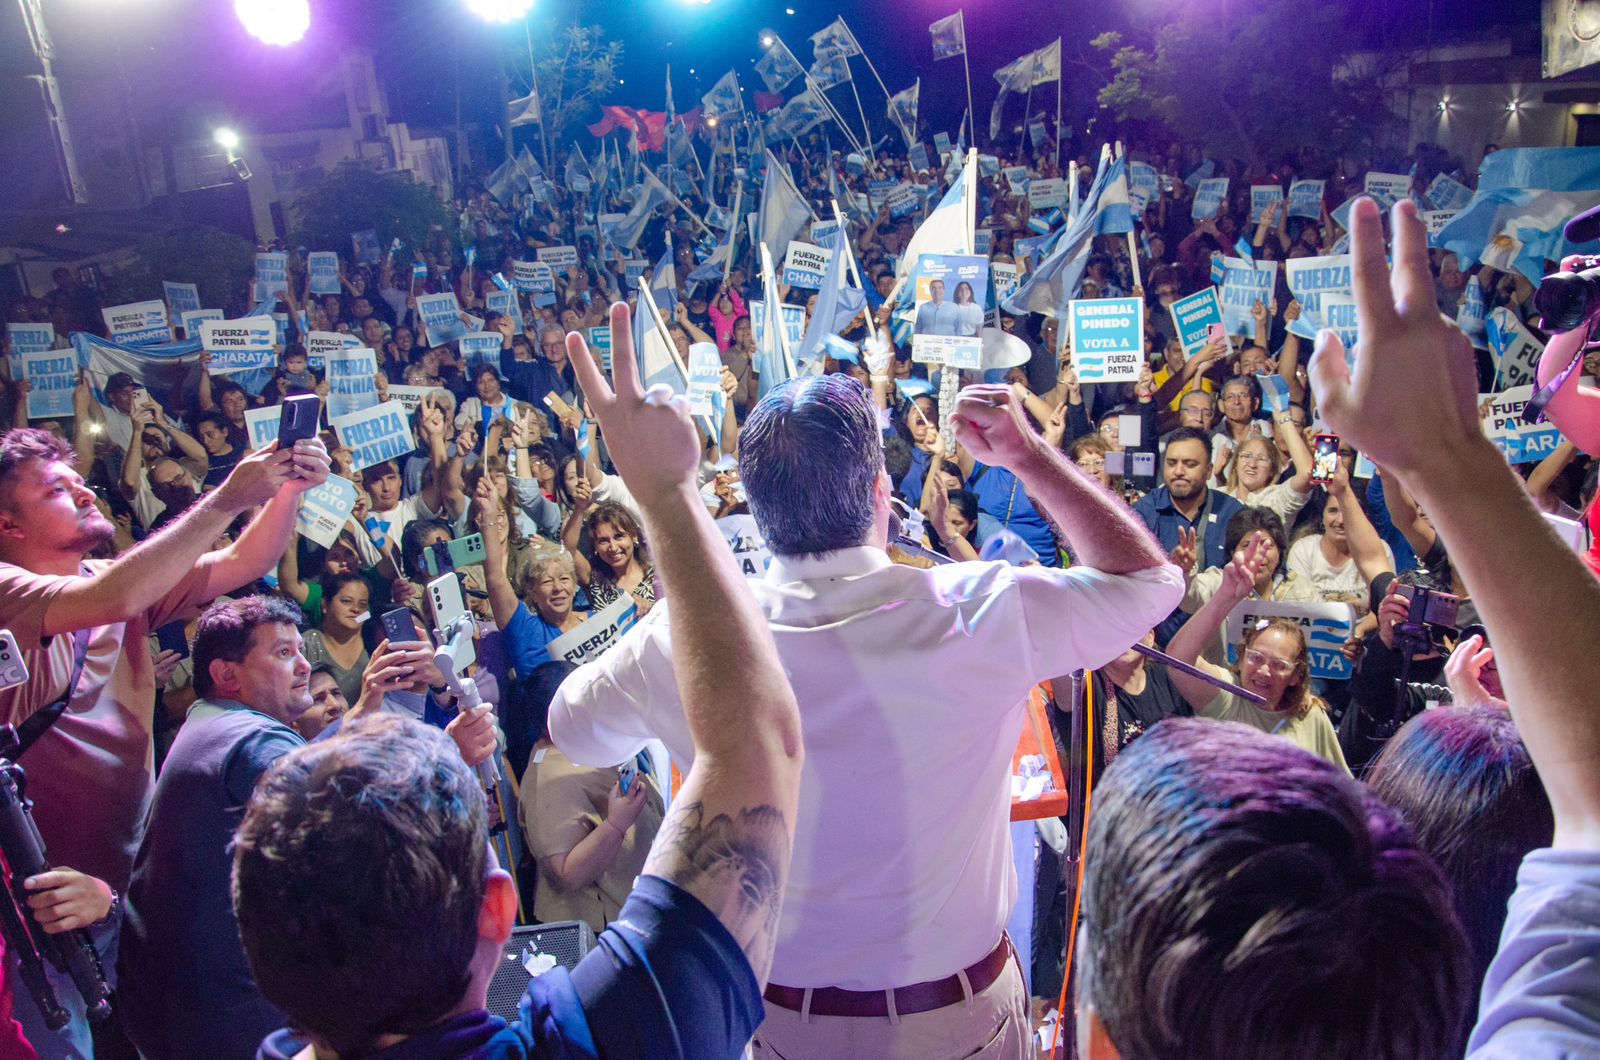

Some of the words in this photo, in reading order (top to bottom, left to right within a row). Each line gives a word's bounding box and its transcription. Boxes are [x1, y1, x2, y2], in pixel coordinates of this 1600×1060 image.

[793, 250, 825, 263] FUERZA
[792, 258, 820, 271] PATRIA
[1226, 267, 1271, 288] FUERZA
[1294, 266, 1351, 290] FUERZA
[422, 299, 456, 313] FUERZA
[1176, 294, 1213, 316] GENERAL
[1296, 292, 1321, 312] PAT
[1077, 304, 1134, 316] GENERAL
[1182, 306, 1213, 325] PINEDO
[112, 312, 145, 323] FUERZA
[424, 312, 461, 328] PATRIA
[1081, 317, 1130, 330] PINEDO
[114, 320, 144, 331] PATRIA
[115, 328, 169, 344] CHARATA
[211, 329, 250, 337] FUERZA
[212, 338, 247, 346] PATRIA
[310, 338, 343, 346] FUERZA
[1083, 339, 1117, 349] VOTA
[1120, 337, 1130, 348] A
[210, 351, 272, 364] CHARATA
[704, 353, 717, 365] YO
[1107, 355, 1137, 363] FUERZA
[28, 358, 74, 375] FUERZA
[330, 358, 374, 376] FUERZA
[1107, 366, 1135, 375] PATRIA
[30, 374, 77, 391] PATRIA
[330, 376, 375, 394] PATRIA
[341, 411, 404, 447] FUERZA
[351, 434, 410, 469] PATRIA
[324, 480, 344, 494] YO
[310, 486, 348, 512] VOTO
[564, 623, 618, 662] FUERZA
